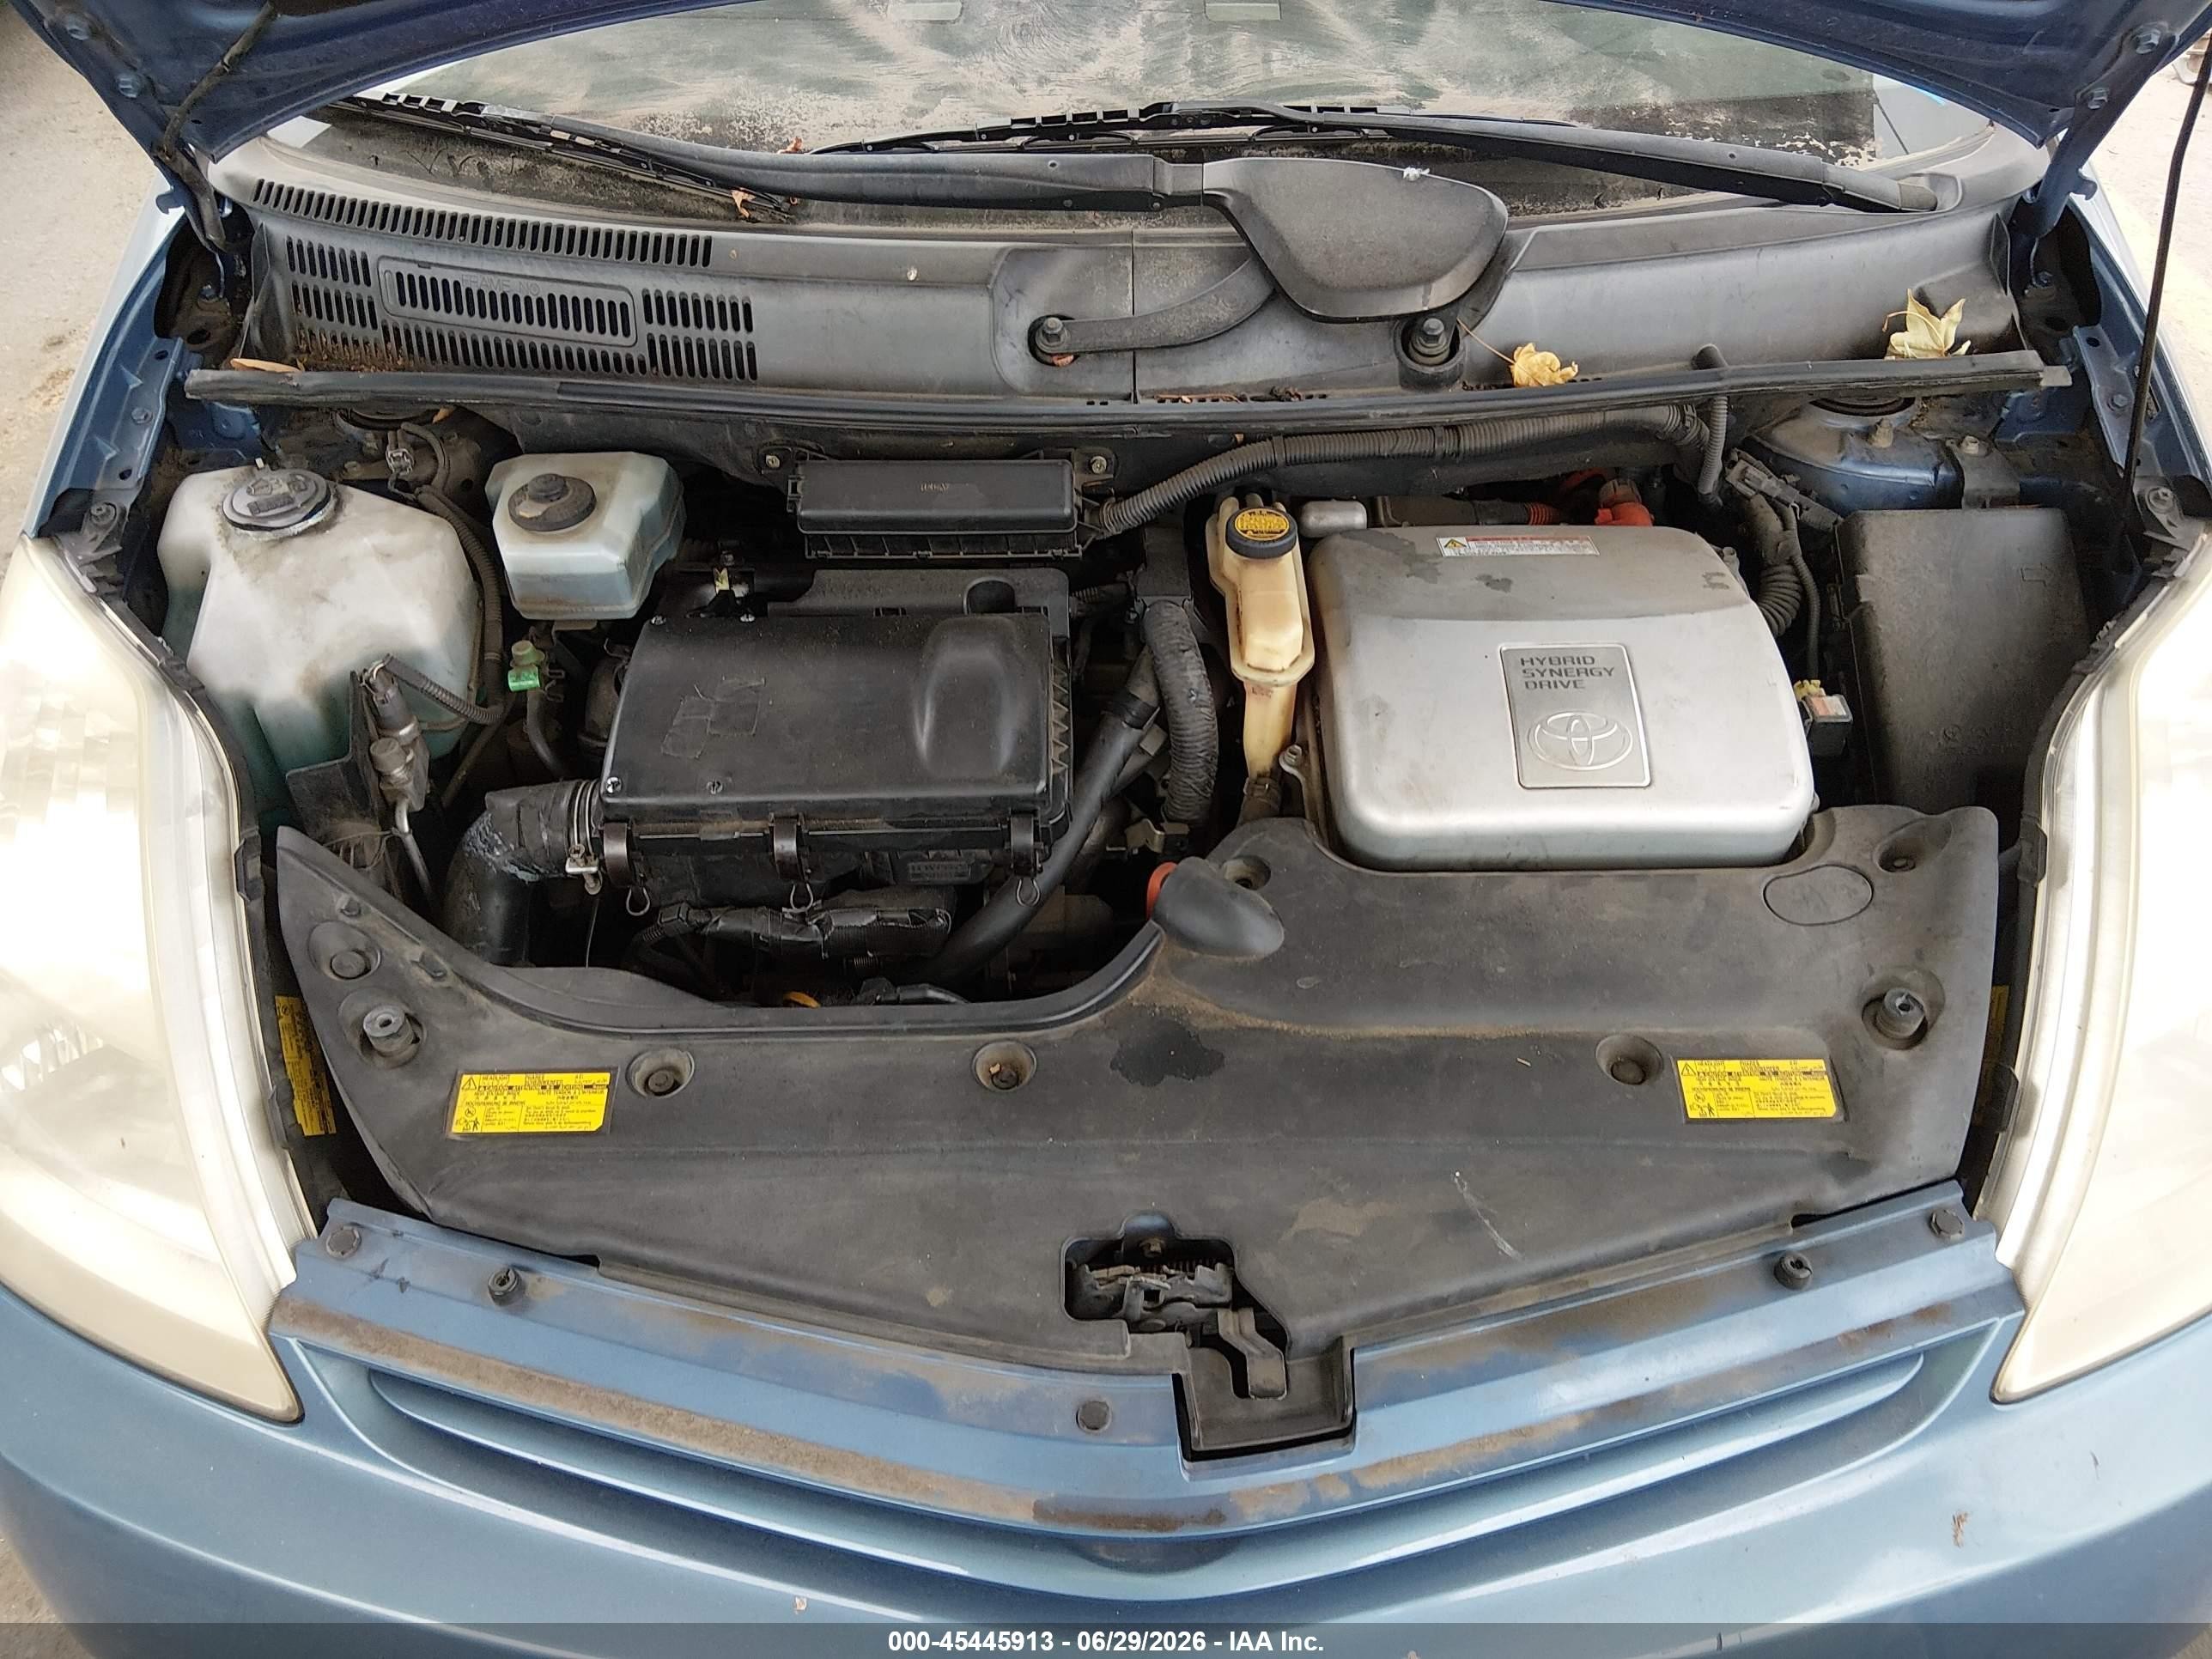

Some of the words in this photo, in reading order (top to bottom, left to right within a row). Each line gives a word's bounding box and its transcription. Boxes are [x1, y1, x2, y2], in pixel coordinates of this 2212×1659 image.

[1520, 655, 1595, 666] HYBRID
[1522, 666, 1614, 678] SYNERGY
[1524, 679, 1585, 690] DRIVE
